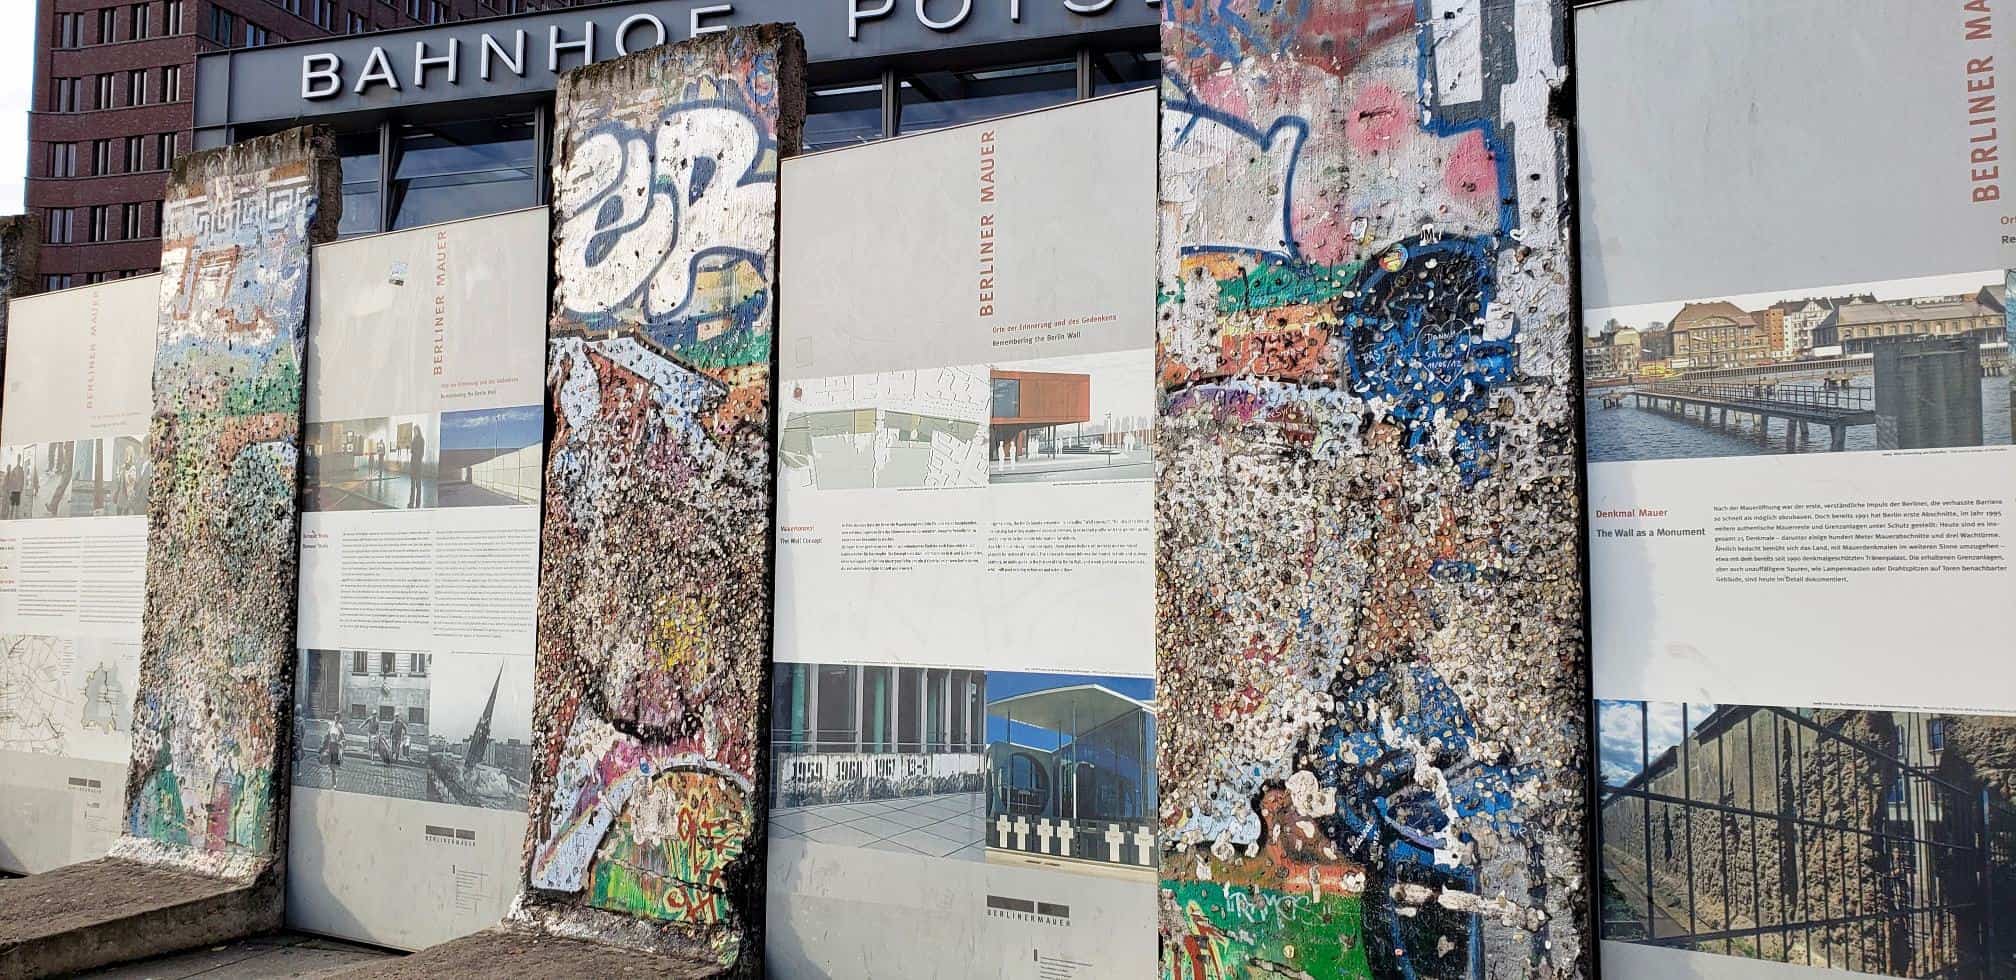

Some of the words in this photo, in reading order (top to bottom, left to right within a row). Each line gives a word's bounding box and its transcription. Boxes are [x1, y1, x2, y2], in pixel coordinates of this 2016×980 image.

[302, 4, 733, 100] BAHNHOF
[1966, 55, 2000, 202] BERLINER
[981, 130, 995, 202] MAUER
[436, 230, 448, 286] MAUER
[980, 213, 994, 317] BERLINER
[434, 295, 445, 376] BERLINER
[1047, 333, 1065, 341] Berlin
[1067, 331, 1081, 339] Wall
[1054, 319, 1066, 327] und
[1596, 509, 1635, 518] Denkmal
[1639, 508, 1668, 517] Mauer
[1597, 529, 1613, 537] The
[1614, 528, 1634, 537] Wall
[1657, 527, 1706, 537] Monument
[987, 909, 1071, 926] BERLINERMAUER
